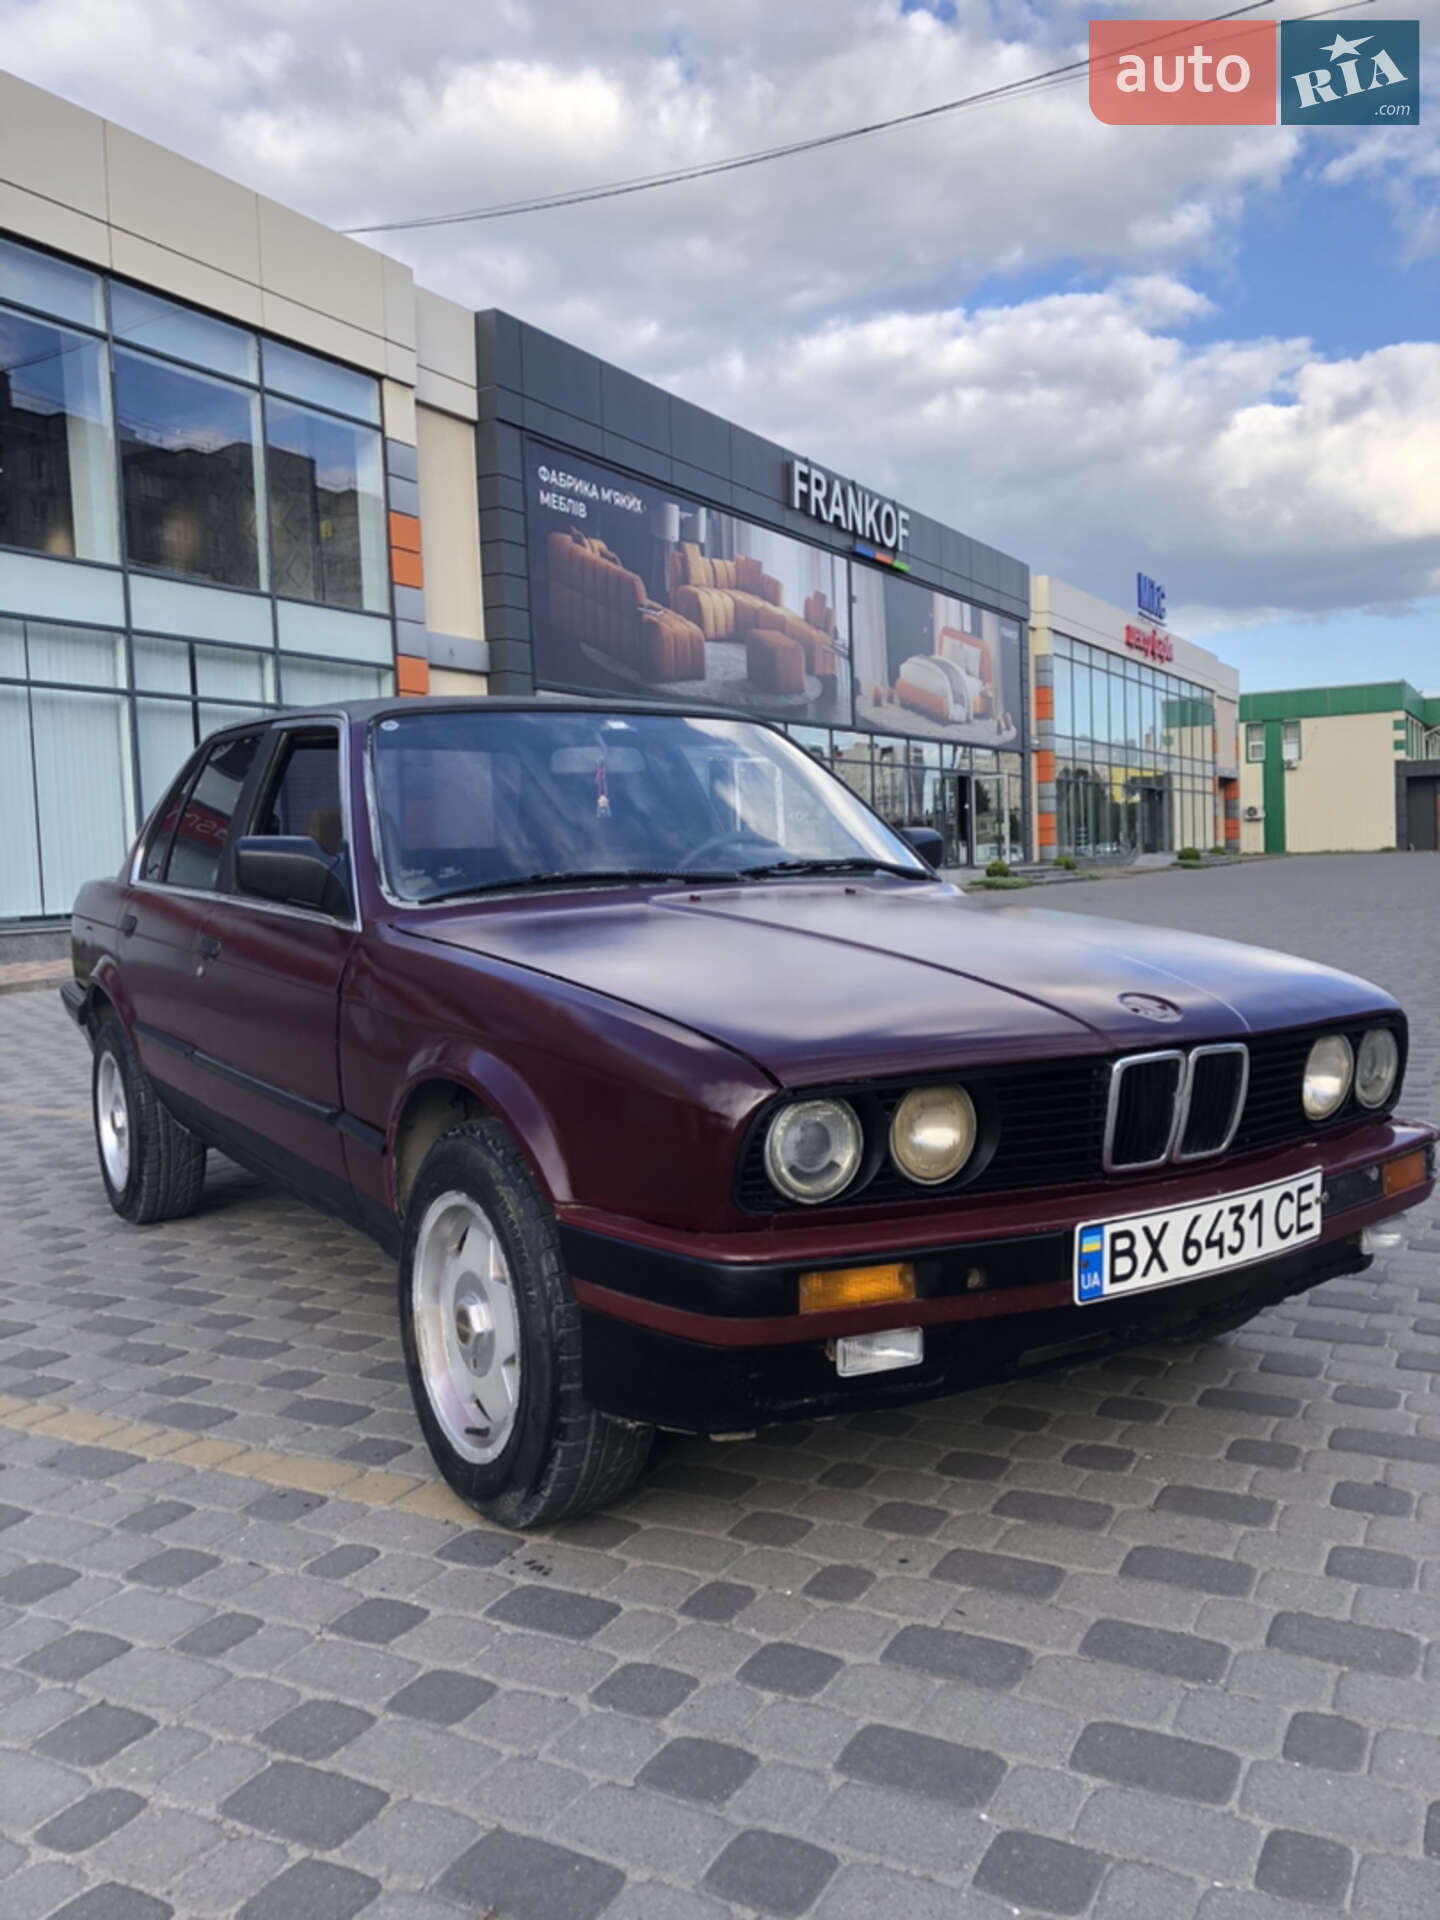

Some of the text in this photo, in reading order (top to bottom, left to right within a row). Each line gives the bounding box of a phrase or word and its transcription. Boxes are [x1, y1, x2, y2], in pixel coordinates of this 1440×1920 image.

[538, 465, 599, 500] ФАБРИКА
[539, 490, 588, 519] МЕБЛІВ
[793, 459, 910, 551] FRANKOF
[1109, 1182, 1315, 1285] BX 6431 CE
[1081, 1271, 1101, 1290] UA
